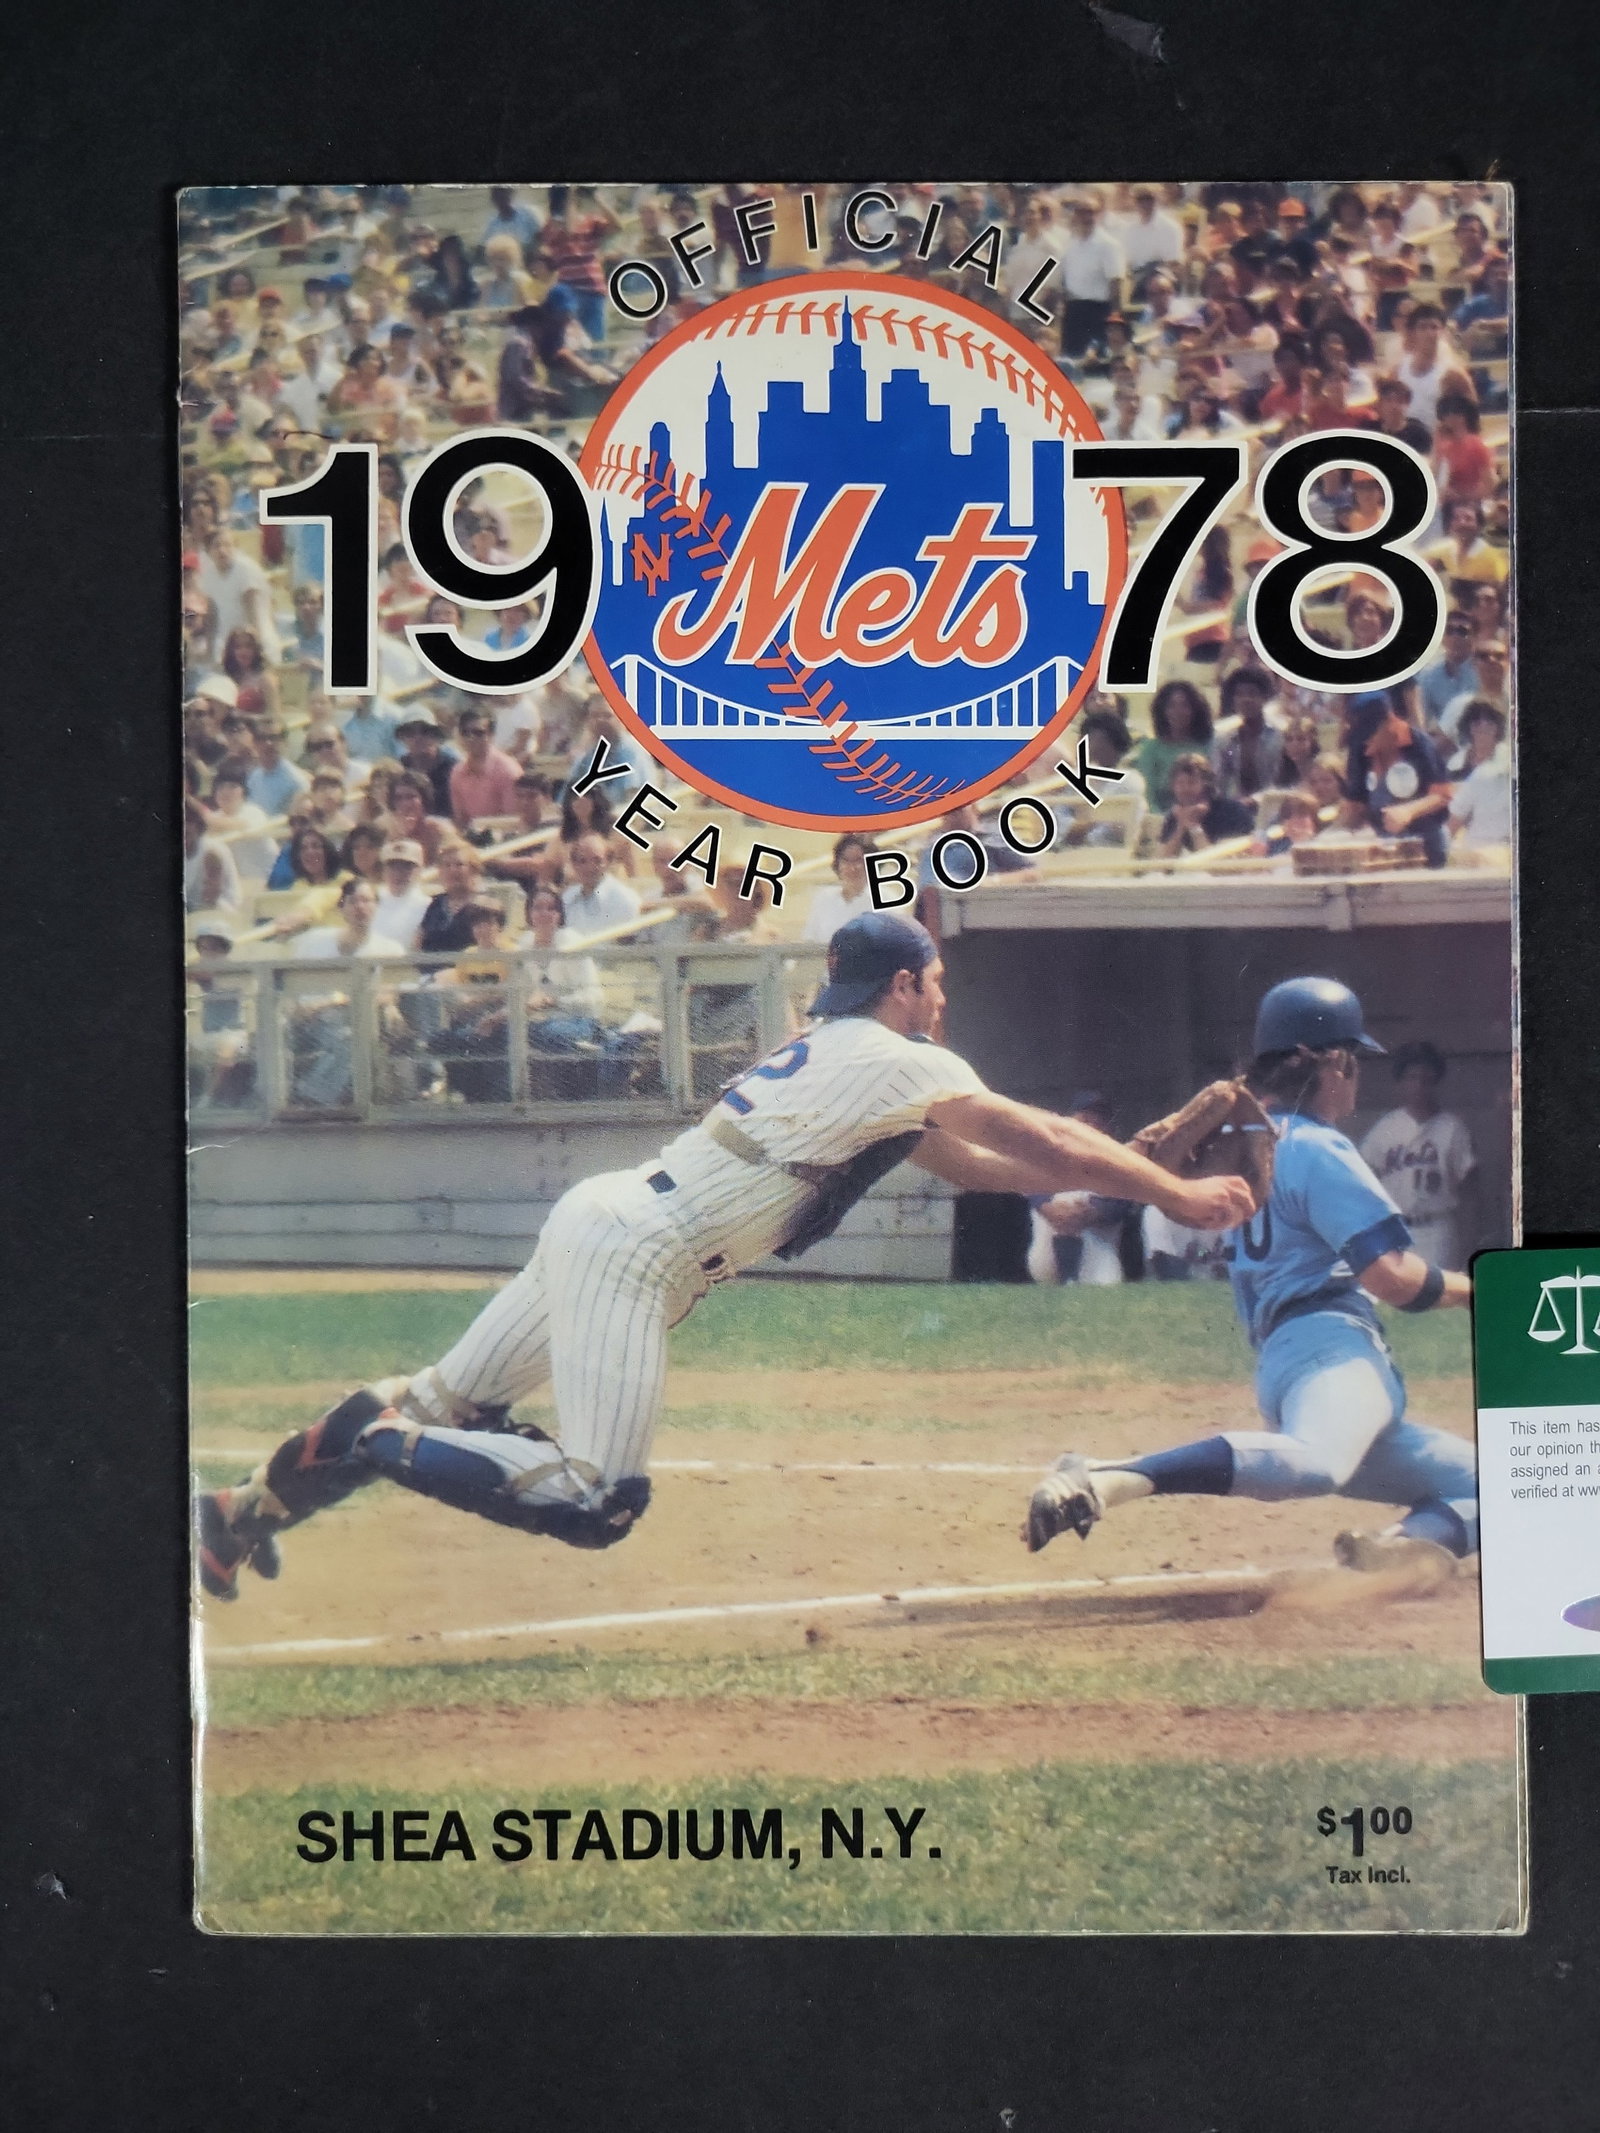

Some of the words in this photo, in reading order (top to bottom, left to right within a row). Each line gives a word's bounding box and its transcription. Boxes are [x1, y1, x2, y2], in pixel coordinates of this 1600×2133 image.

[608, 190, 1060, 326] OFFICIAL
[260, 428, 602, 695] 19
[653, 481, 1038, 668] Mets
[1073, 428, 1446, 693] 78
[571, 736, 794, 909] YEAR
[864, 735, 1125, 911] BOOK
[1509, 1420, 1537, 1435] This
[1543, 1420, 1571, 1434] item
[1577, 1419, 1600, 1433] has
[1510, 1445, 1532, 1457] our
[1537, 1441, 1584, 1459] opinion
[1510, 1462, 1569, 1480] assigned
[1575, 1464, 1591, 1476] an
[1511, 1484, 1558, 1499] verified
[1562, 1484, 1574, 1498] at
[296, 1809, 476, 1863] SHEA
[491, 1808, 801, 1871] STADIUM,
[821, 1807, 942, 1860] N.Y.
[1325, 1866, 1363, 1884] Tax
[1367, 1865, 1412, 1884] Incl.
